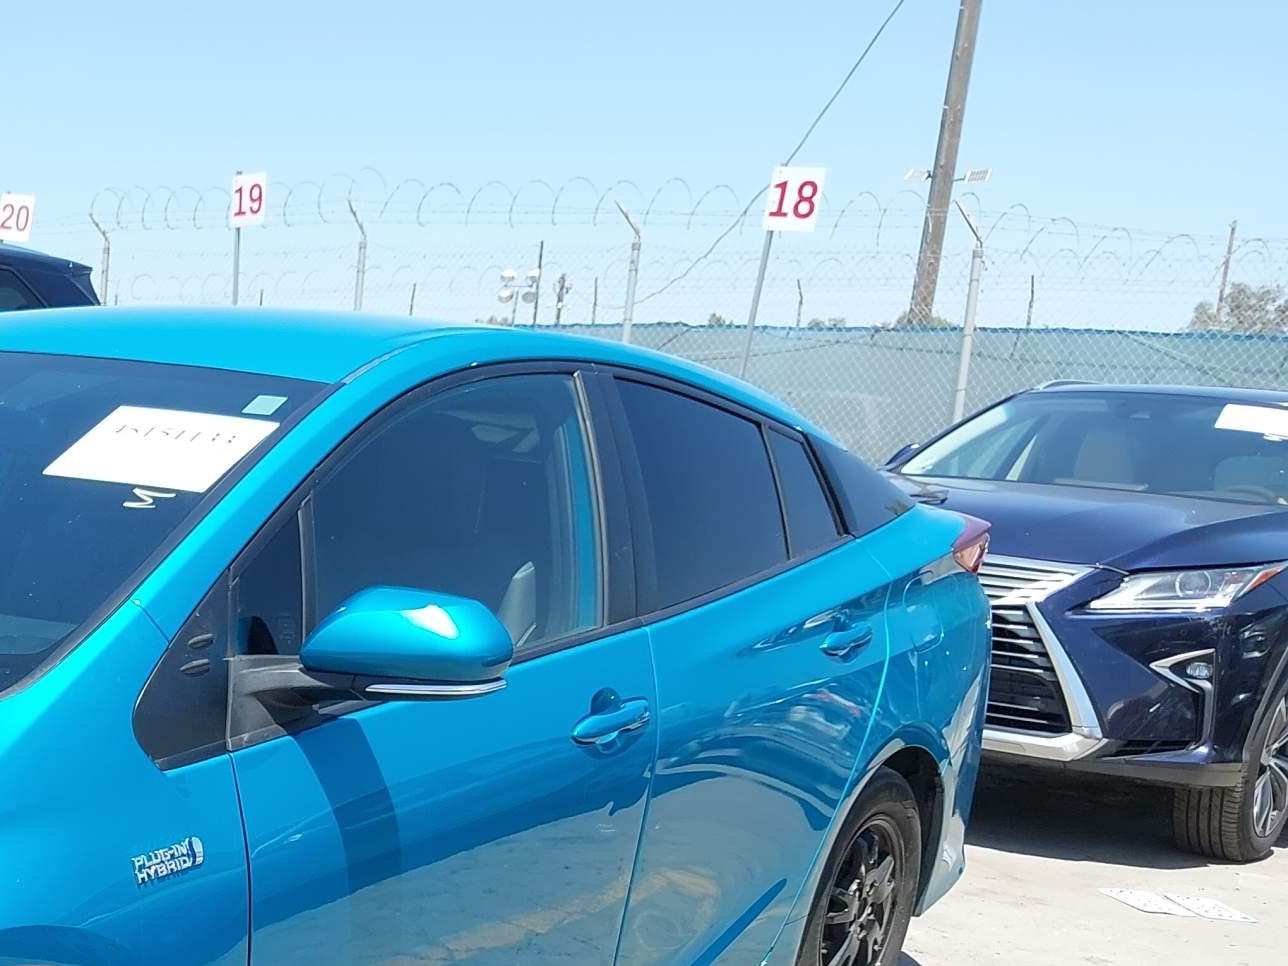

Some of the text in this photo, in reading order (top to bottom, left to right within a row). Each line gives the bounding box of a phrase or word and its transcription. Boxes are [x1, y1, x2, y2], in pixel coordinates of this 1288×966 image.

[233, 183, 263, 217] 19
[768, 180, 818, 219] 18
[0, 203, 30, 232] 20
[131, 838, 190, 868] PLUG-IN
[135, 856, 193, 884] HYBRID
